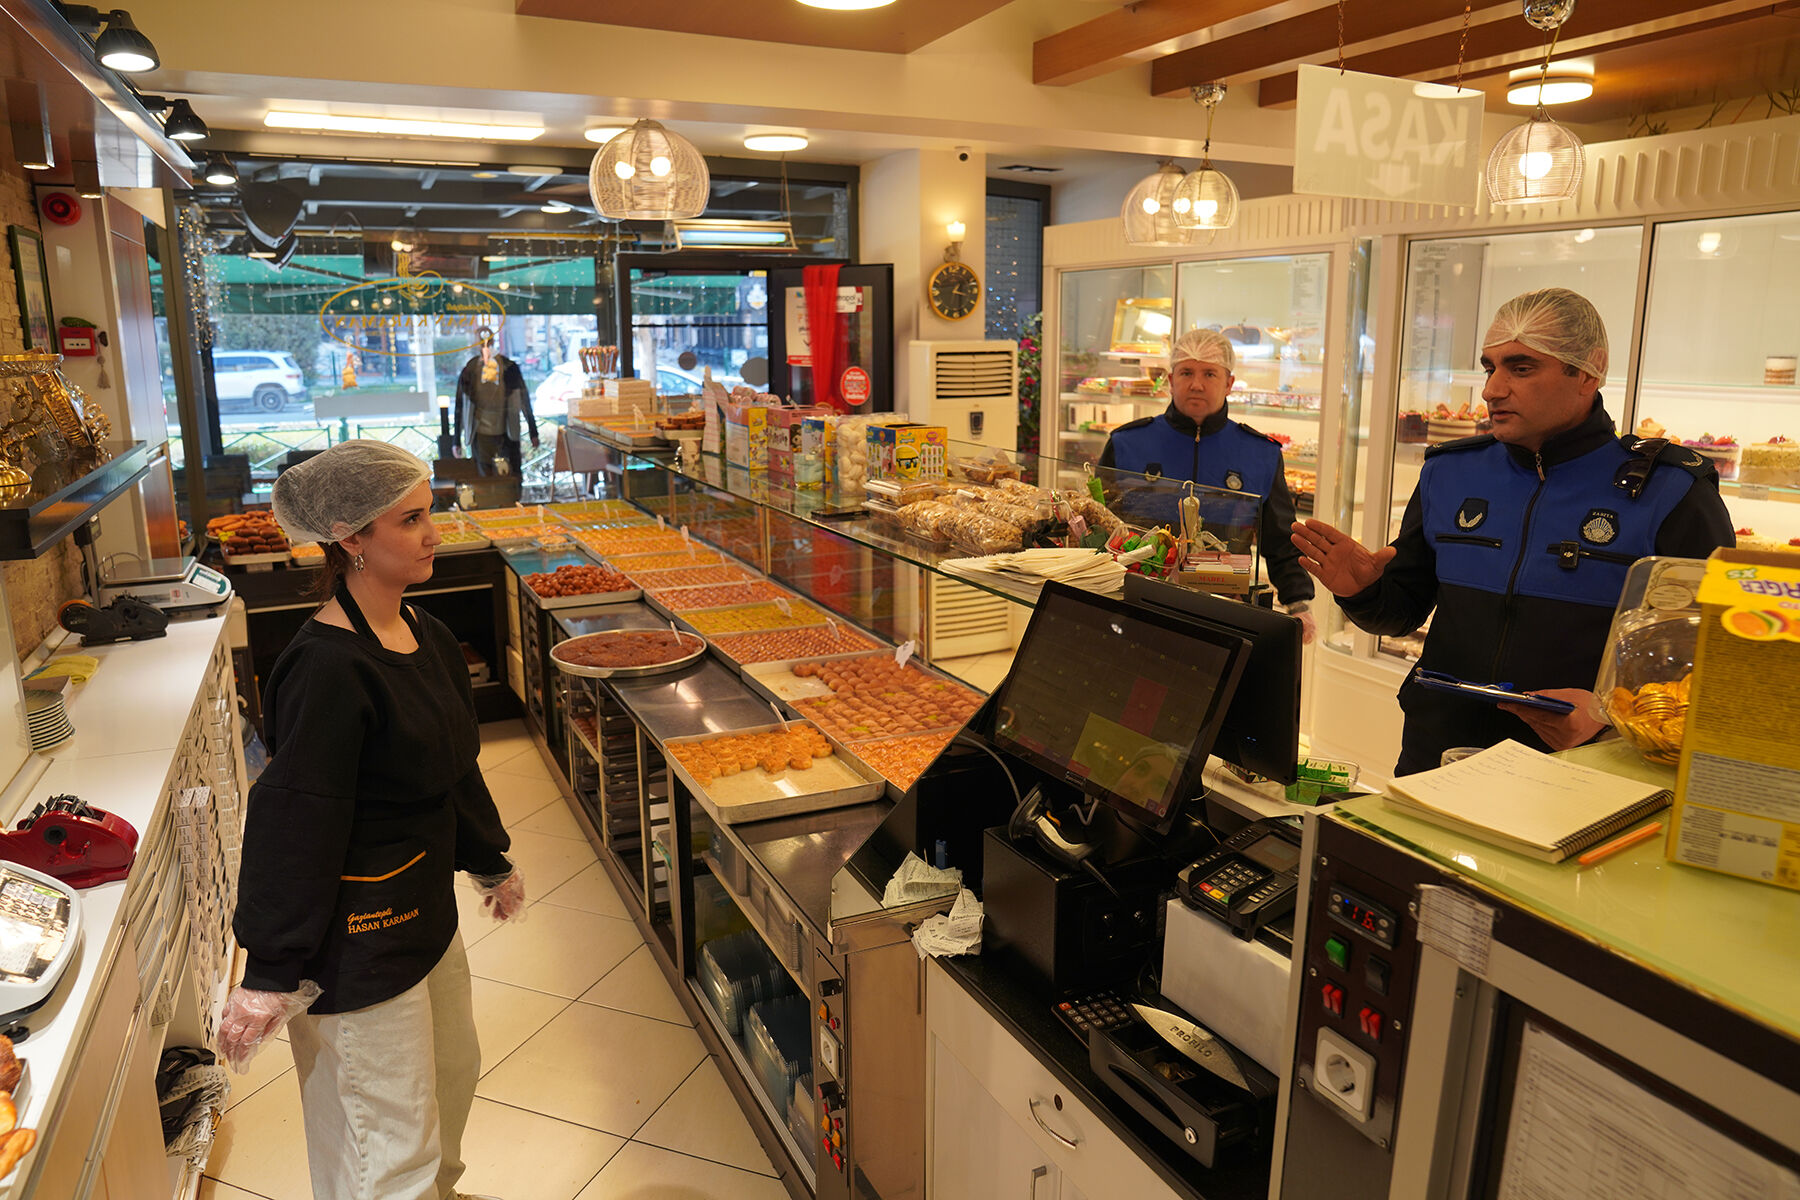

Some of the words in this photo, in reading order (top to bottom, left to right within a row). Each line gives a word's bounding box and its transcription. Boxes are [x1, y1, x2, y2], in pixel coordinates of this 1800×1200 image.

[347, 907, 392, 925] Gaziantepli
[348, 921, 380, 934] HASAN
[382, 908, 419, 928] KARAMAN
[1169, 1025, 1212, 1057] PROFILO
